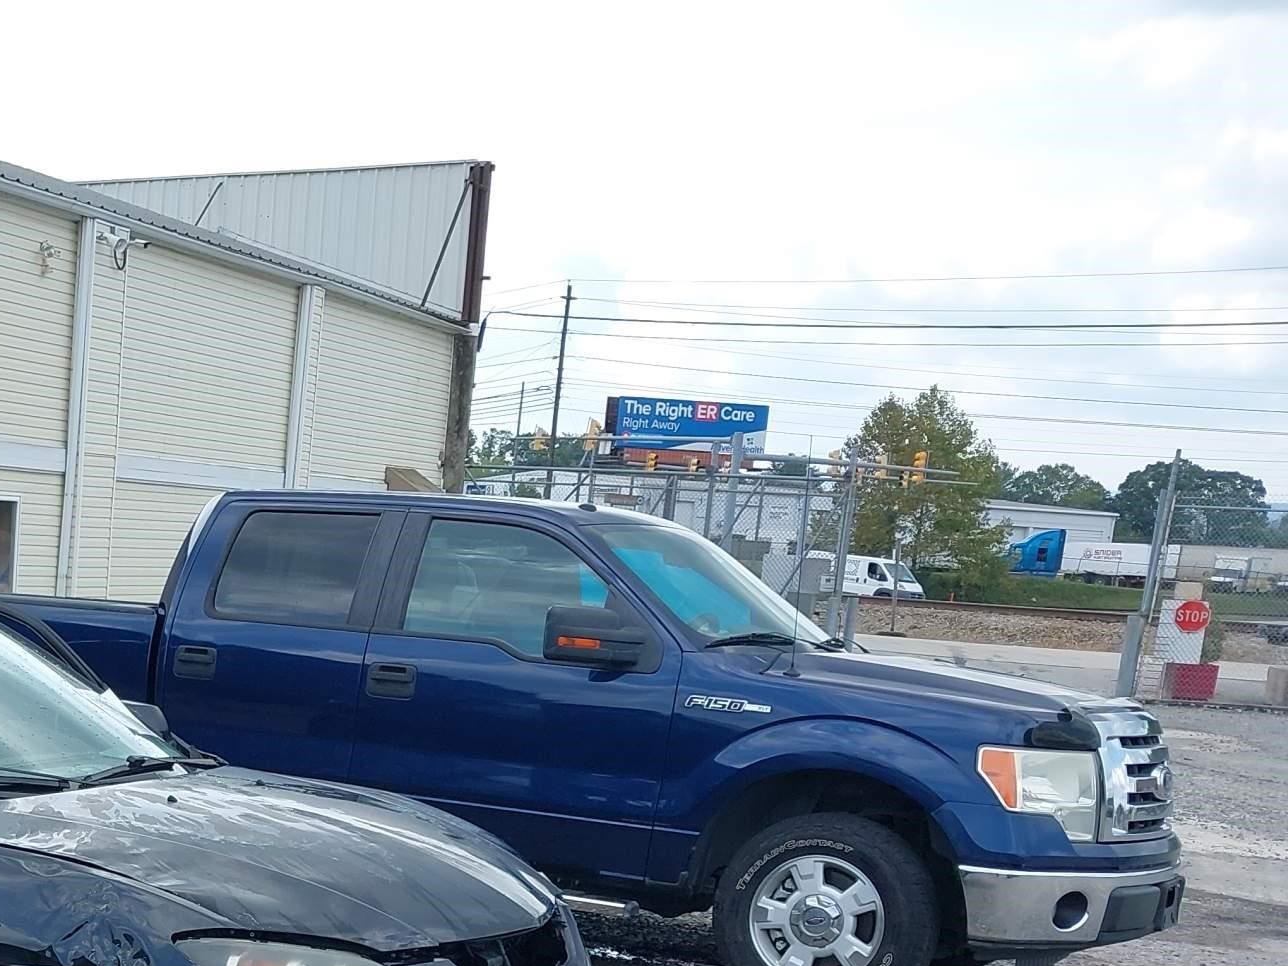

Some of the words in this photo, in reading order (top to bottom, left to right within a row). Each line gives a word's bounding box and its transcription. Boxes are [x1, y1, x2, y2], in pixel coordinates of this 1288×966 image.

[624, 399, 652, 415] The
[655, 402, 693, 420] Right
[697, 405, 717, 419] ER
[720, 406, 755, 422] Care
[622, 417, 649, 431] Right
[650, 420, 681, 432] Away
[711, 443, 765, 454] veealth
[1176, 609, 1209, 623] STOP
